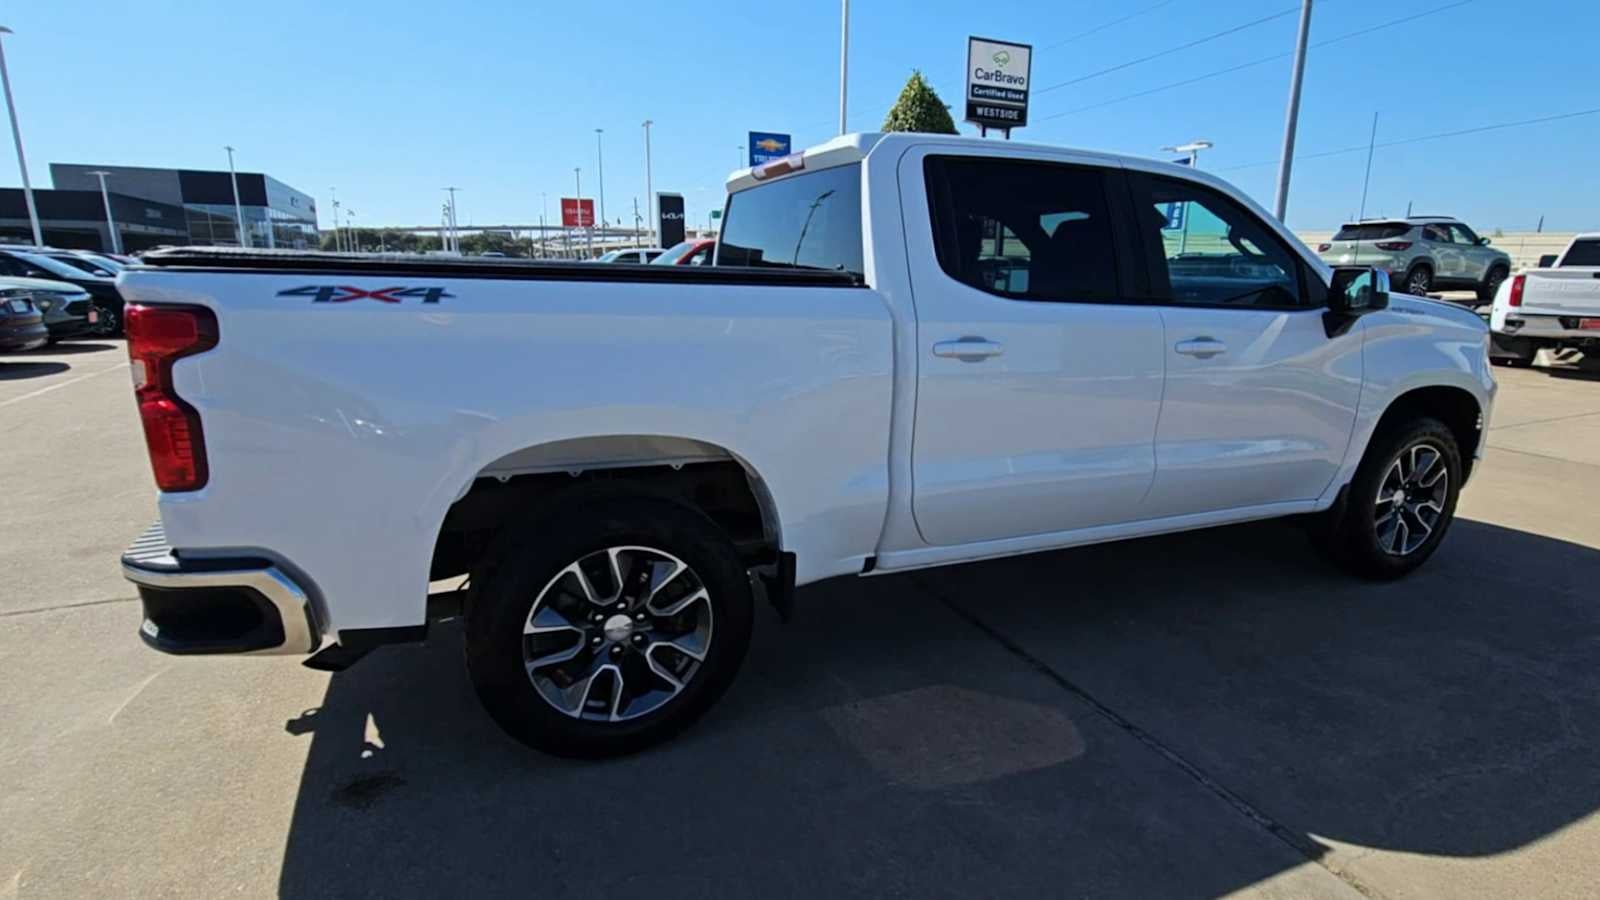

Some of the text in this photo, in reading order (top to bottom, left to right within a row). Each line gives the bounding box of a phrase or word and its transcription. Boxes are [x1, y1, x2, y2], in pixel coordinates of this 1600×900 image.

[974, 67, 1025, 85] CarBravo
[973, 86, 1025, 100] Certified Used
[975, 106, 1020, 120] WESTSIDE
